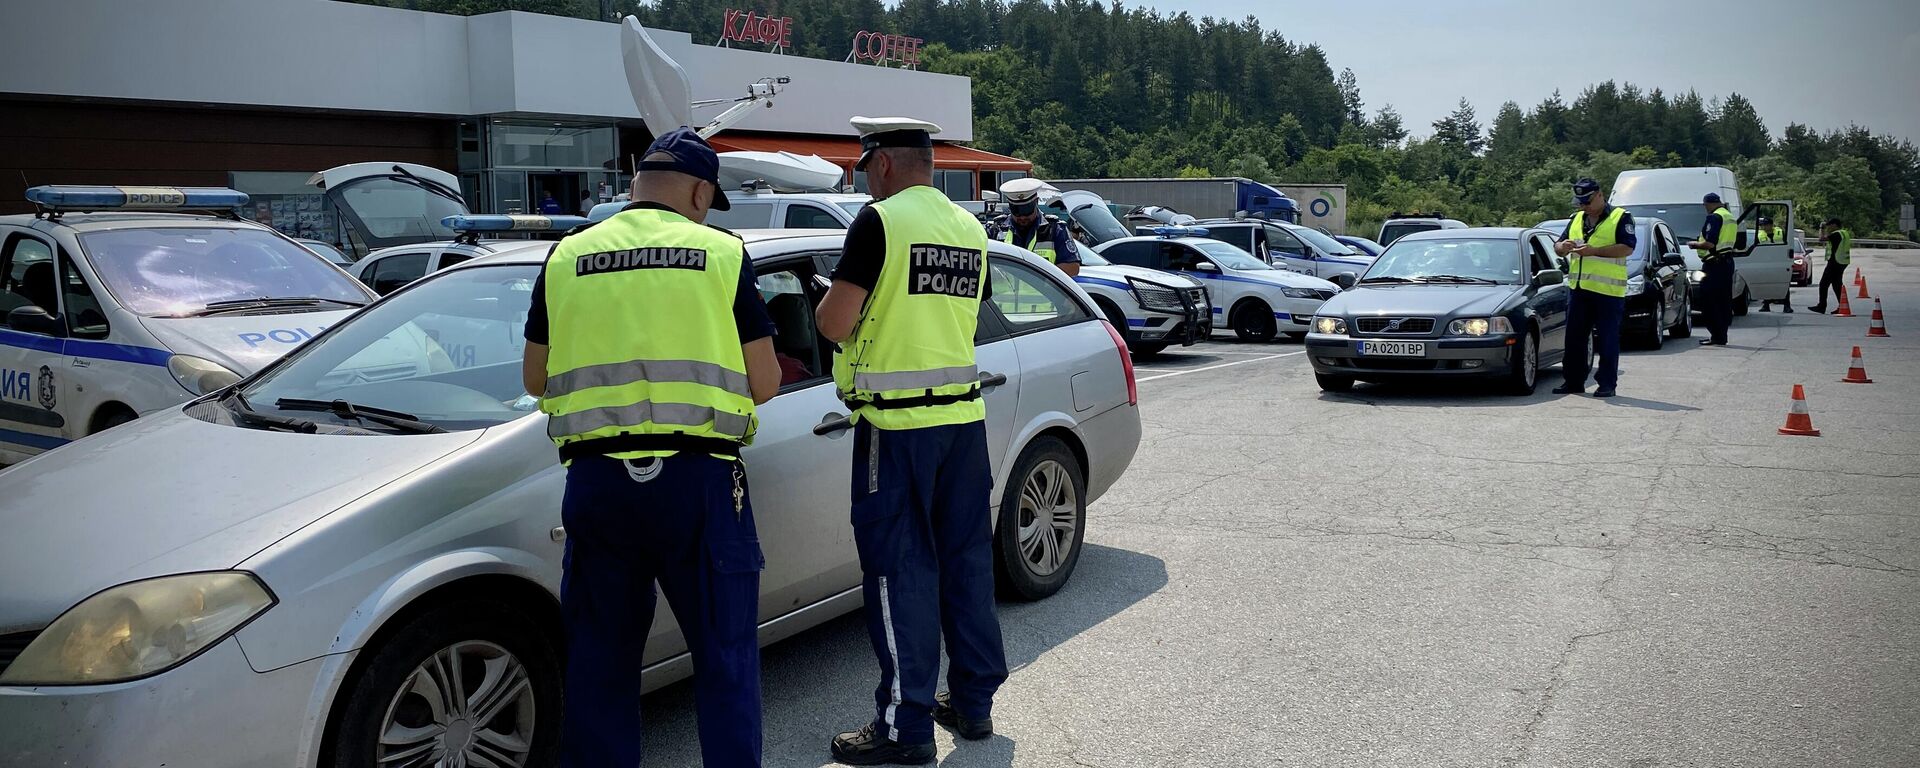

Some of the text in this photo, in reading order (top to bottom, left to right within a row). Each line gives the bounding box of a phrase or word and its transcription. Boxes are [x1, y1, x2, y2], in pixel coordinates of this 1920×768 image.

[723, 8, 792, 47] КАФЕ
[854, 30, 923, 64] COFFEE
[130, 193, 181, 204] POLICE
[577, 248, 705, 273] ПОЛИЦИЯ
[912, 247, 982, 272] TRAFFIC
[917, 273, 978, 296] POLICE
[238, 327, 326, 348] POL
[1364, 343, 1423, 354] PA 0201 BP
[0, 368, 31, 401] ИЯ
